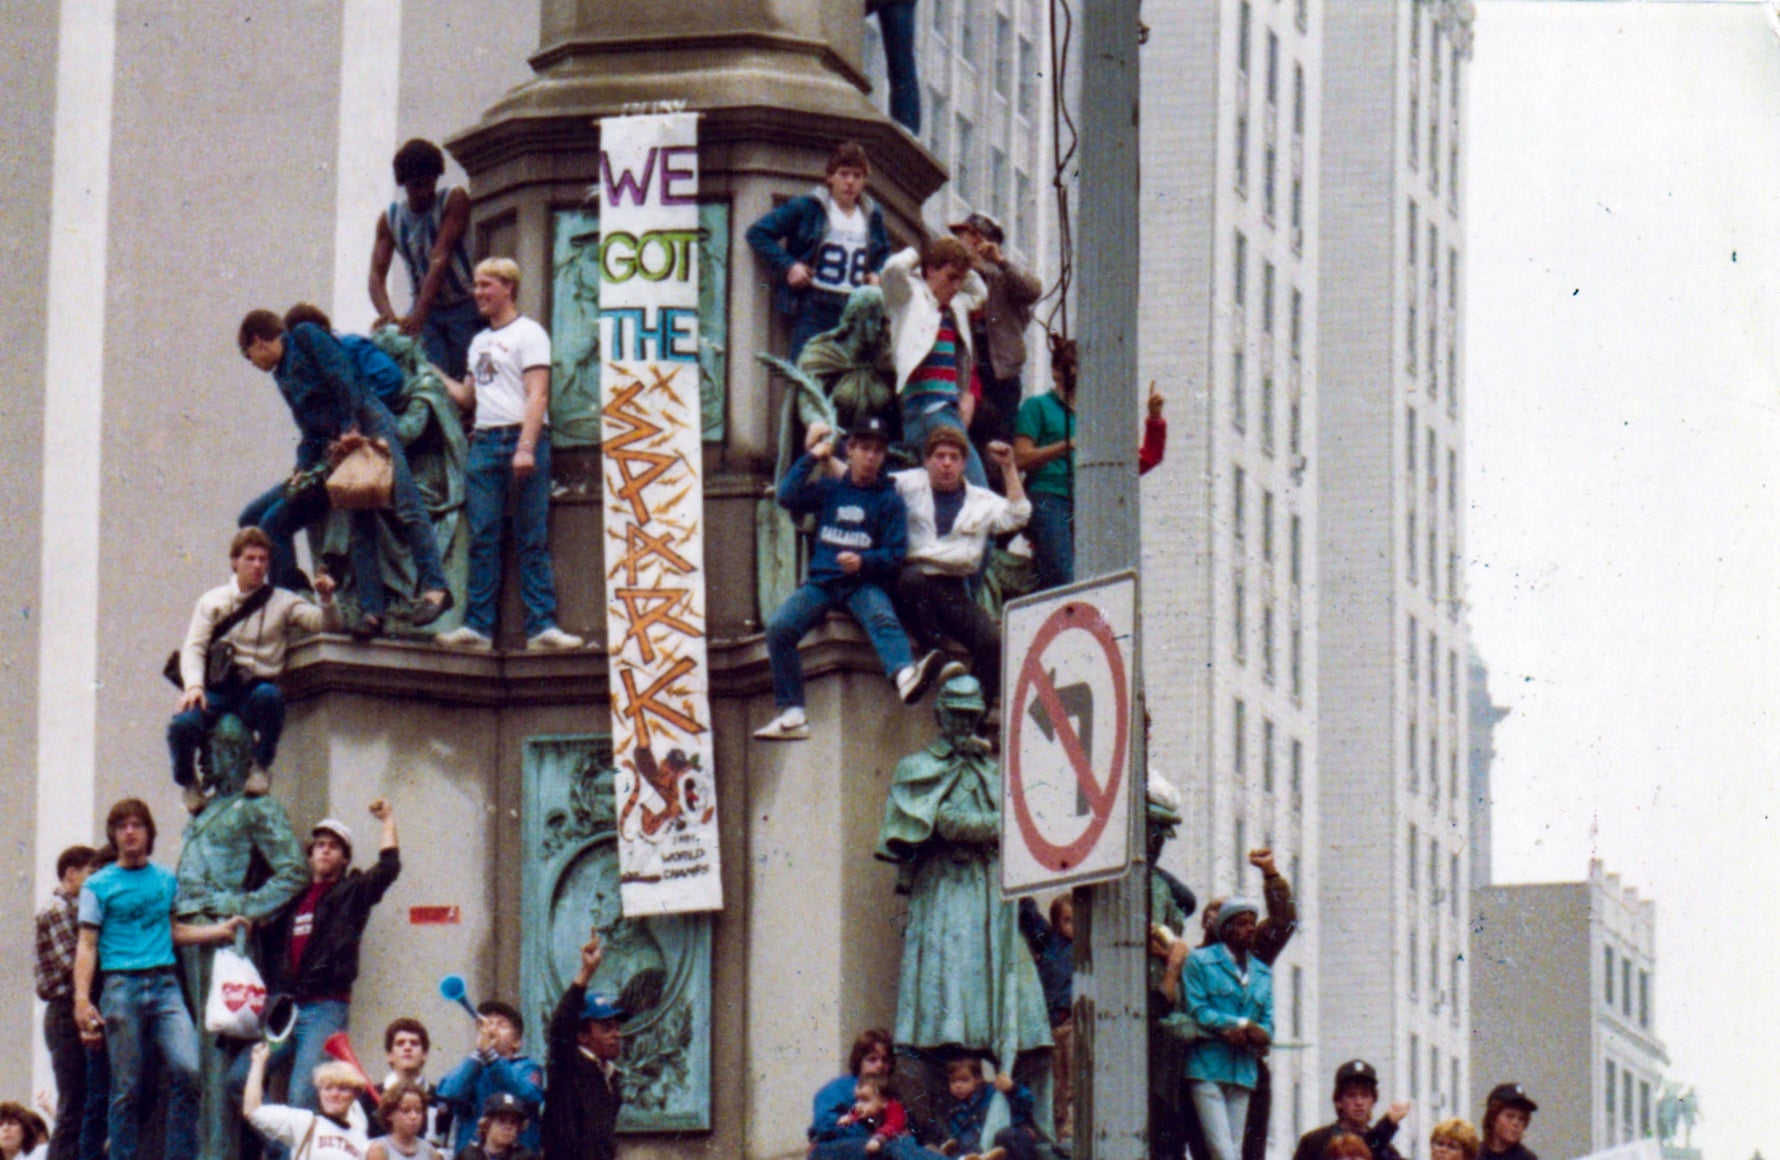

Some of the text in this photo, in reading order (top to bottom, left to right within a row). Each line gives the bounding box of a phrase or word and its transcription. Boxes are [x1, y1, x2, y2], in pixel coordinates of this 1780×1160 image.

[601, 147, 699, 206] WE
[602, 229, 699, 283] GOT
[601, 307, 699, 362] THE
[661, 848, 706, 862] WORLD
